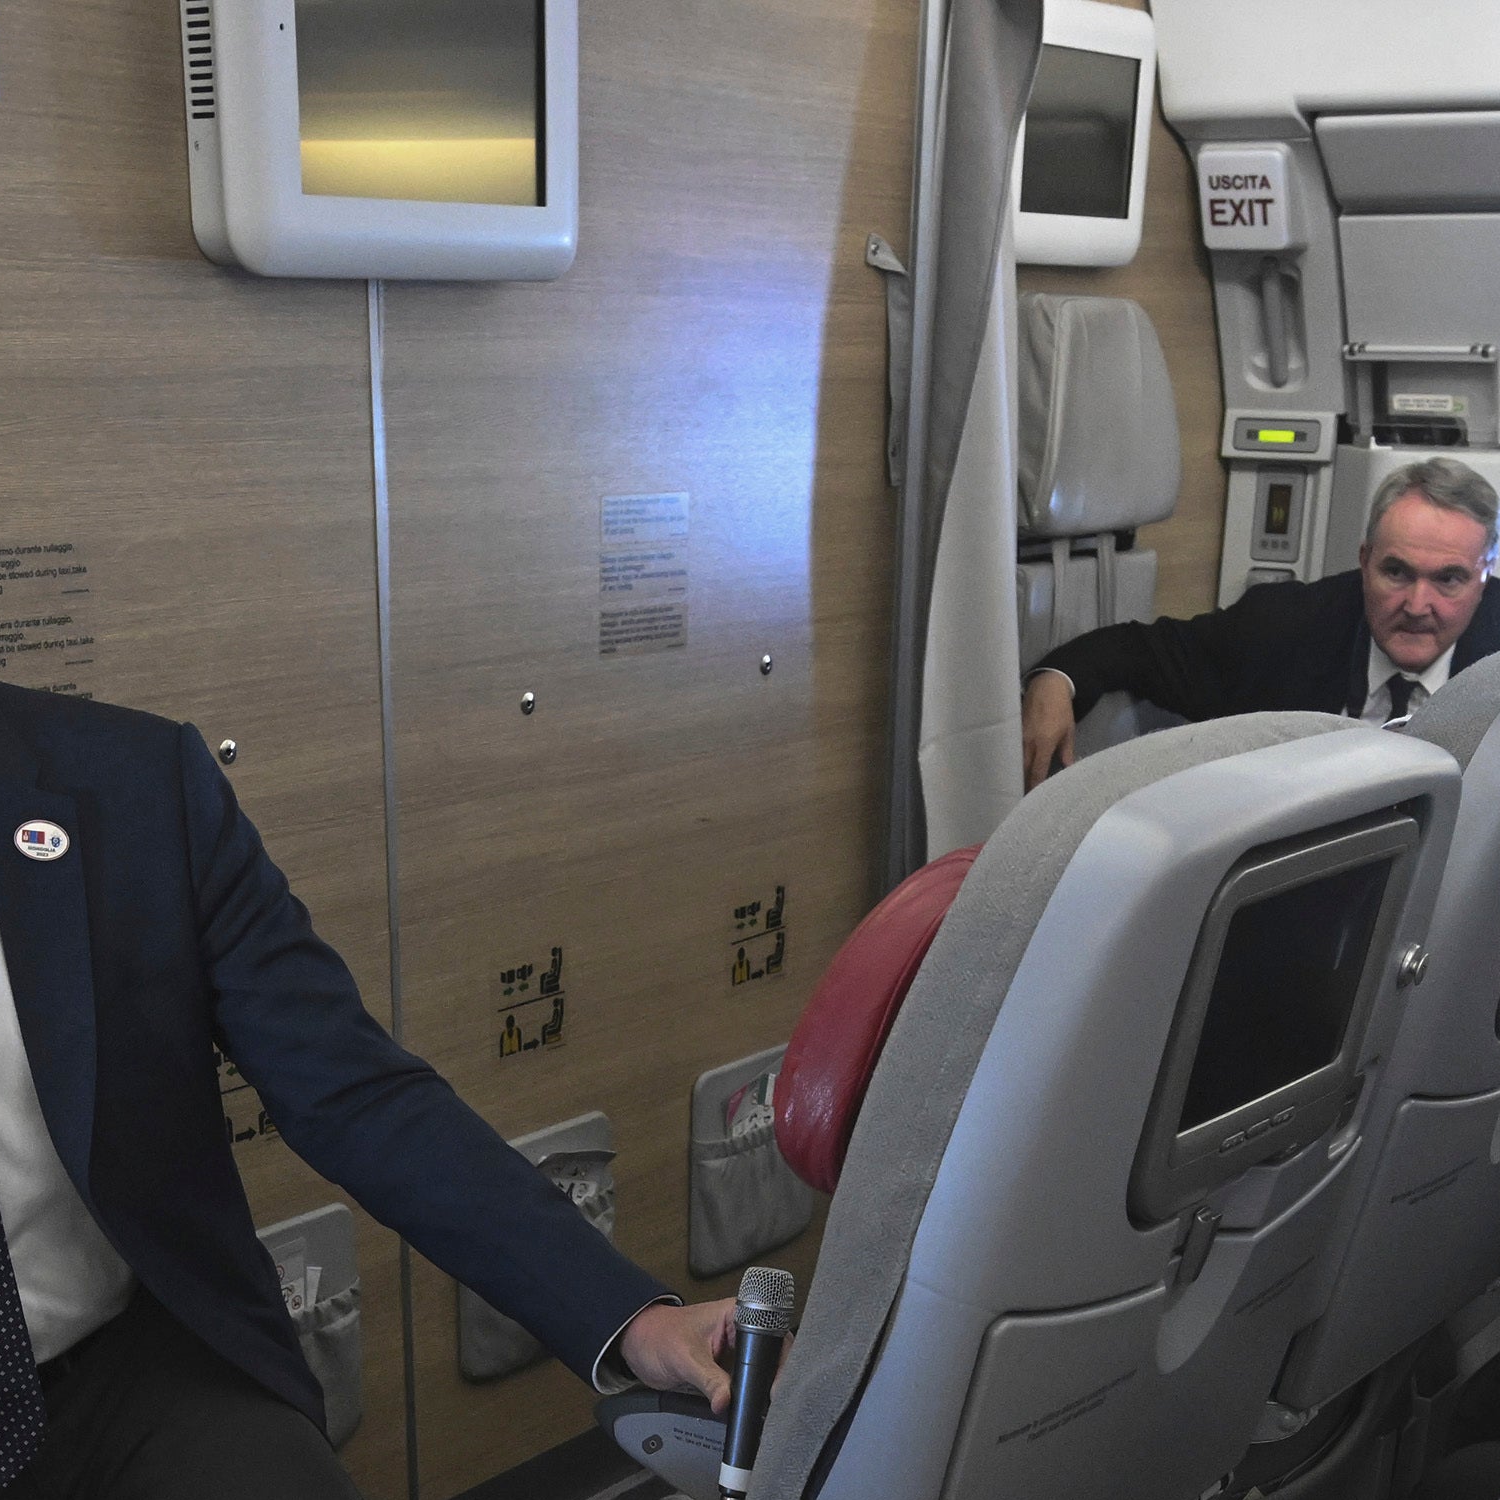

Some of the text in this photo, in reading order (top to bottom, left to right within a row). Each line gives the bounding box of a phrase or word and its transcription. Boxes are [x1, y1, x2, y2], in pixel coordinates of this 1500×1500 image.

[1208, 174, 1271, 190] USCITA
[1209, 198, 1275, 226] EXIT
[14, 545, 42, 555] durante
[8, 570, 33, 579] stowed
[35, 568, 57, 578] during
[14, 619, 40, 629] durante
[43, 640, 65, 649] during
